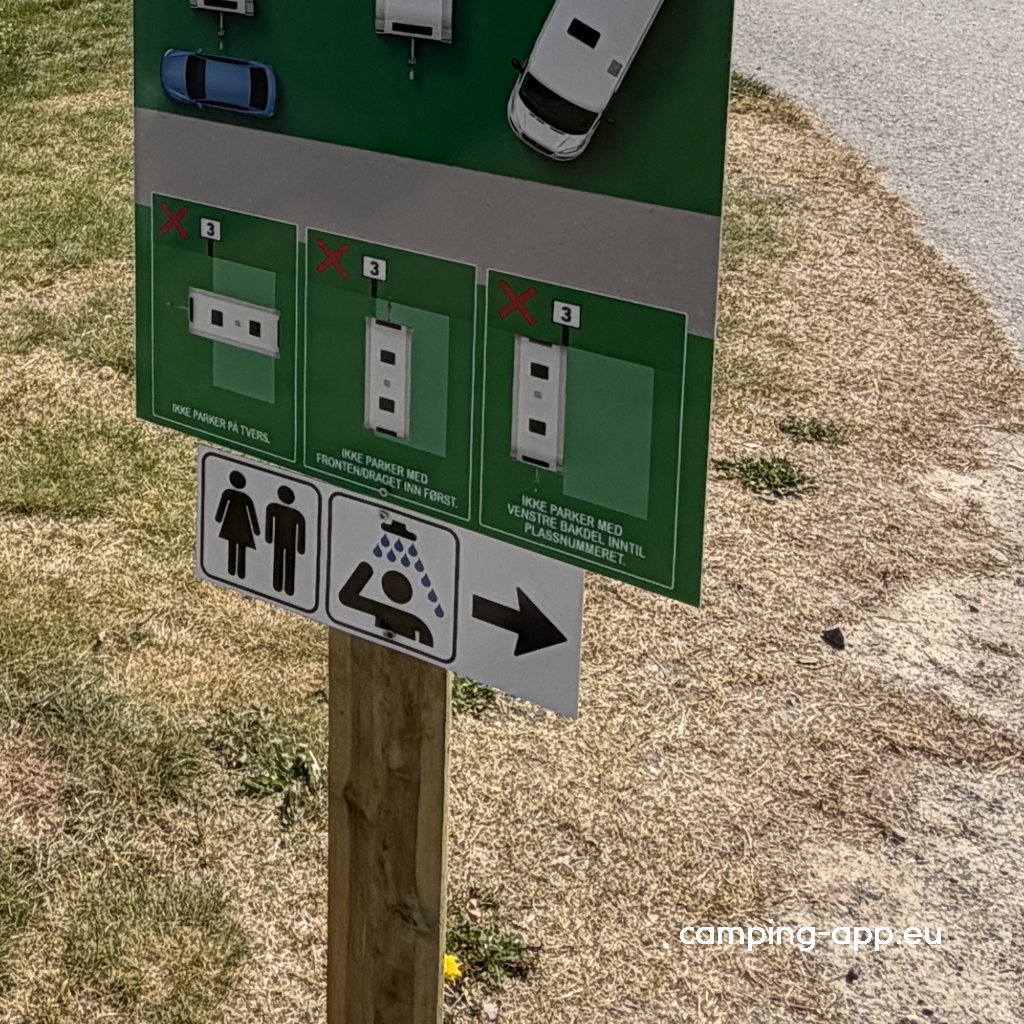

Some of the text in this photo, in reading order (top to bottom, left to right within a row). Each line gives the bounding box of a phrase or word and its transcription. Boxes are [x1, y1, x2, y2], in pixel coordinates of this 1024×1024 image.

[206, 222, 216, 237] 3
[369, 261, 380, 276] 3
[561, 306, 572, 322] 3
[172, 403, 192, 418] IKKE
[193, 409, 226, 430] PARKER
[316, 452, 459, 509] FRONTEN/DRAGET INN FØRST.
[341, 448, 429, 485] IKKE PARKER MED
[507, 503, 646, 559] VENSTRE BAKDEL INNTIL
[521, 495, 623, 537] IKKE PARKER MED
[524, 522, 627, 566] PLASSNUMMERET.
